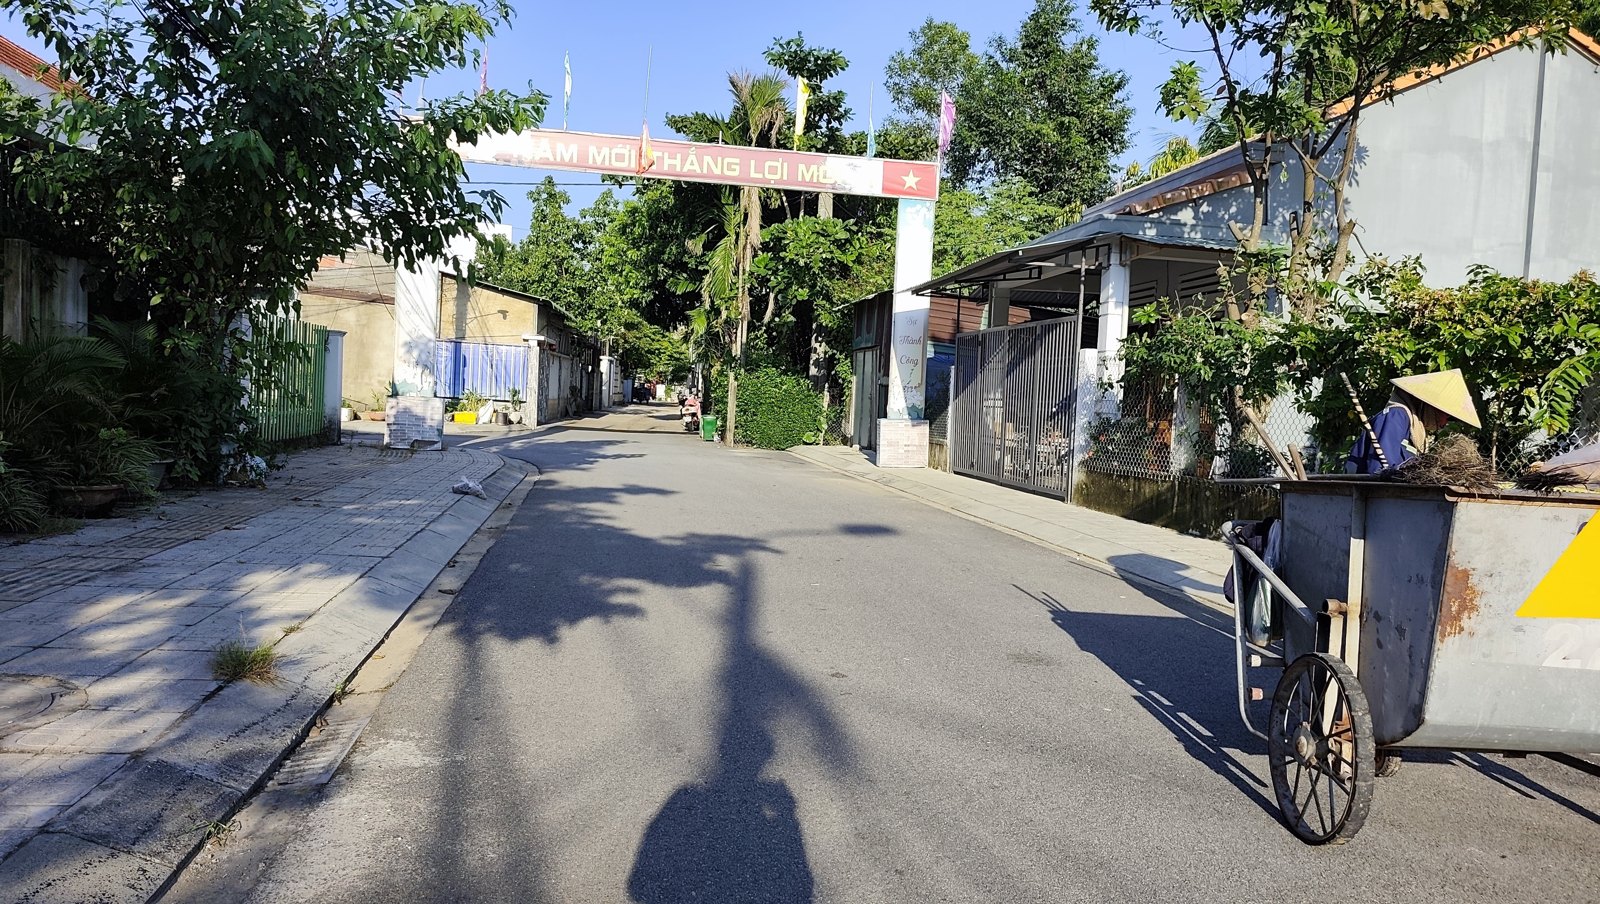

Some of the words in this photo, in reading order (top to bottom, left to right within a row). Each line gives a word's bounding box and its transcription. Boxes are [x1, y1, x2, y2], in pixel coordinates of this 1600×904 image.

[588, 144, 636, 168] MỚI
[651, 147, 741, 177] THẮNG
[749, 157, 788, 184] LỢI
[899, 335, 923, 345] Thành
[900, 354, 919, 368] Công
